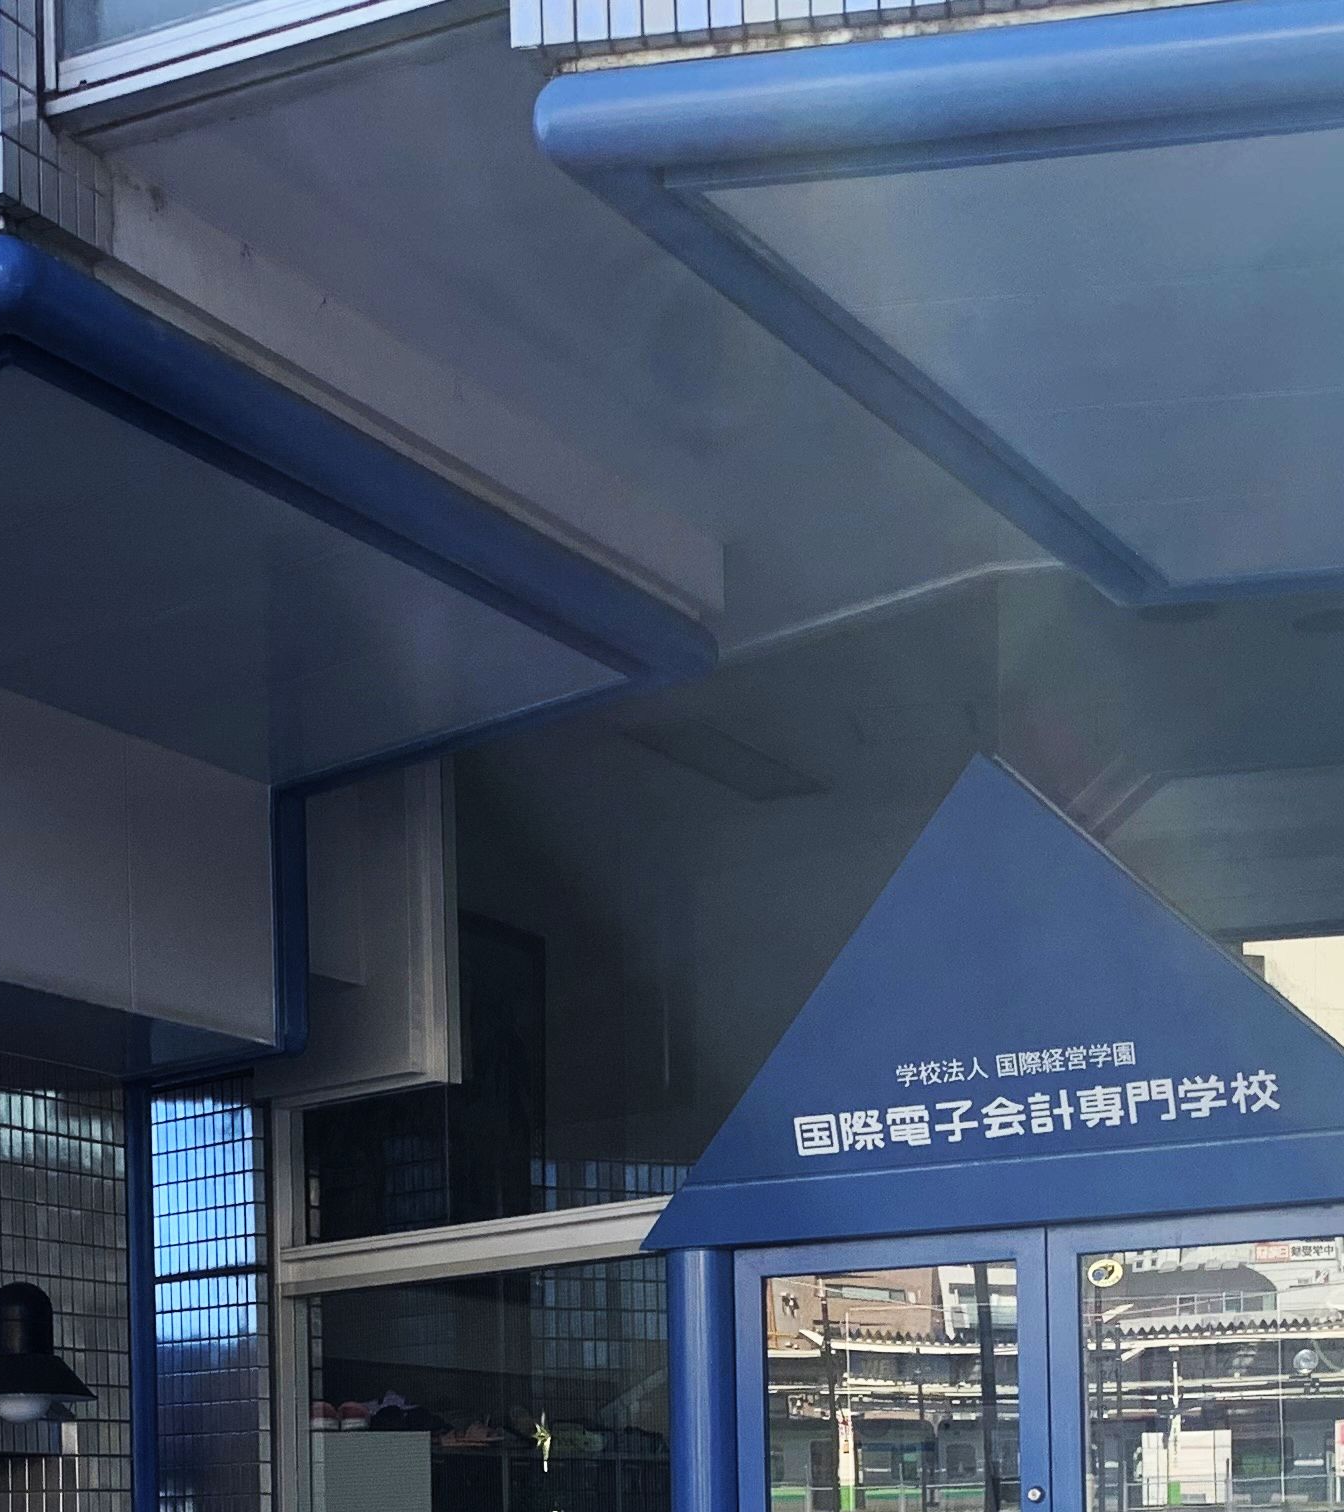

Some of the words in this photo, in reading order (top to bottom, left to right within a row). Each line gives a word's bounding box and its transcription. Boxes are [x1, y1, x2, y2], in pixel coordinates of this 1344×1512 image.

[895, 1055, 989, 1087] 学校法人
[995, 1040, 1137, 1079] 国際経営学園
[792, 1068, 1282, 1158] 国際電子会計専門学校
